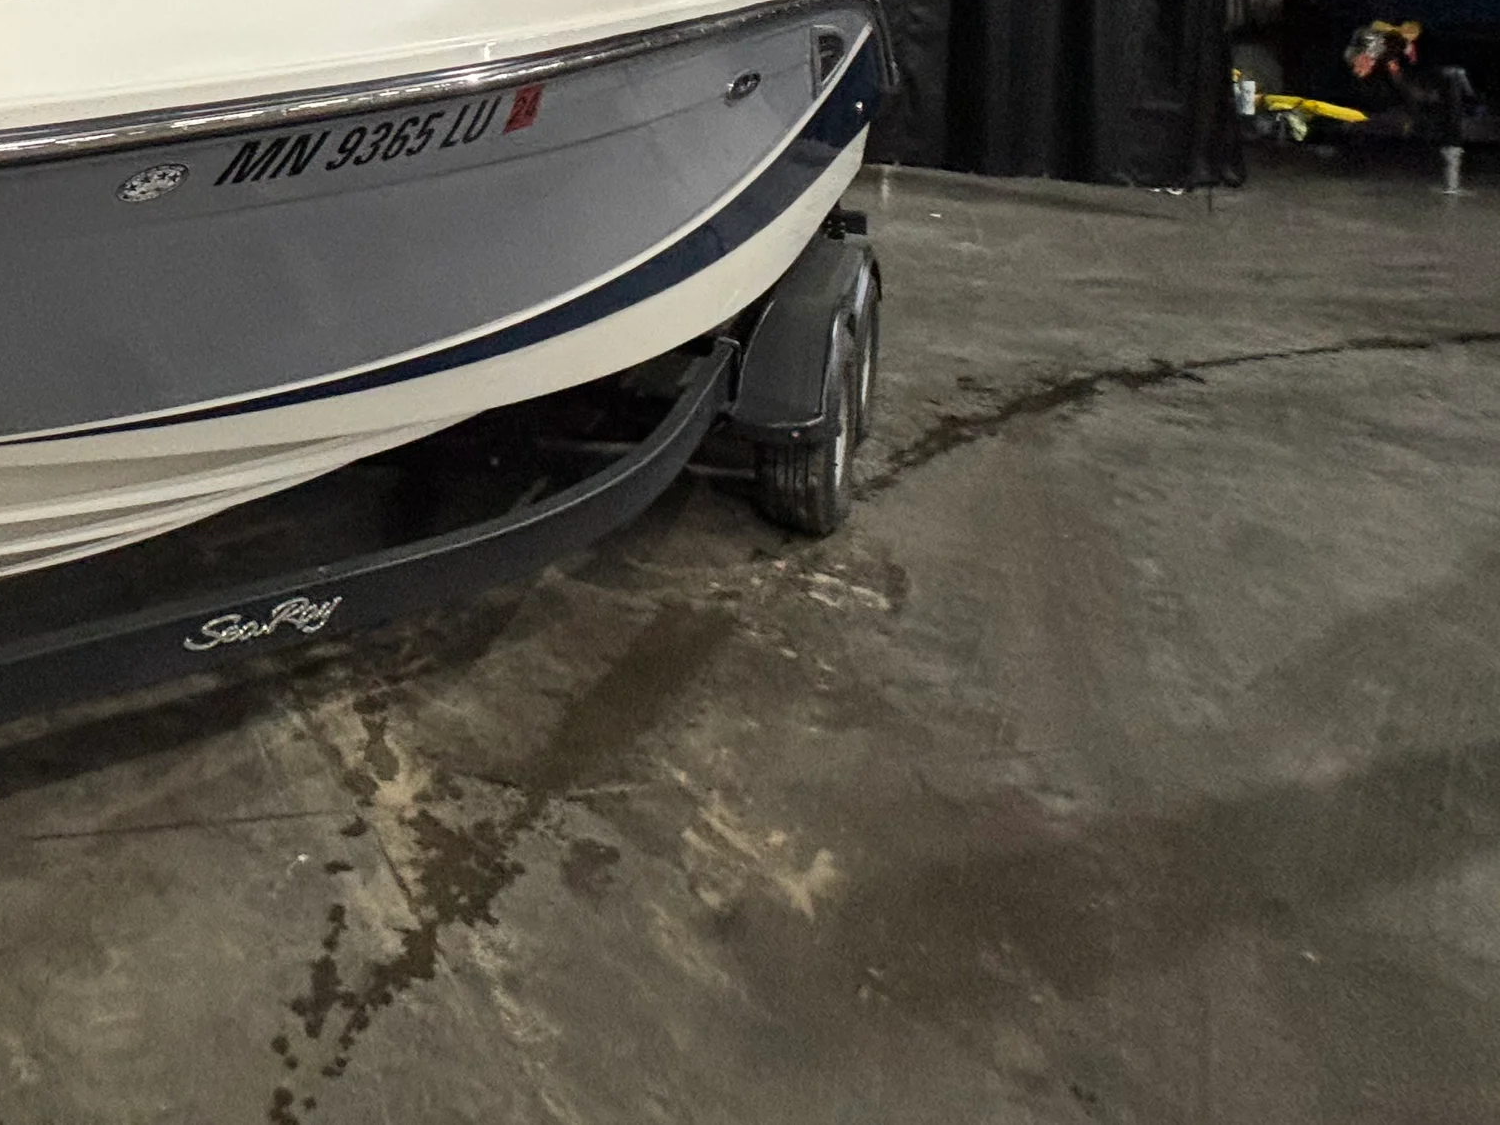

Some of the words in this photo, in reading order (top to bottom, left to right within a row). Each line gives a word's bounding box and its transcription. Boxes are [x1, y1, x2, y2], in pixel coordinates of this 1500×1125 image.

[213, 130, 332, 187] MN
[324, 112, 445, 171] 9365
[438, 95, 502, 149] LU
